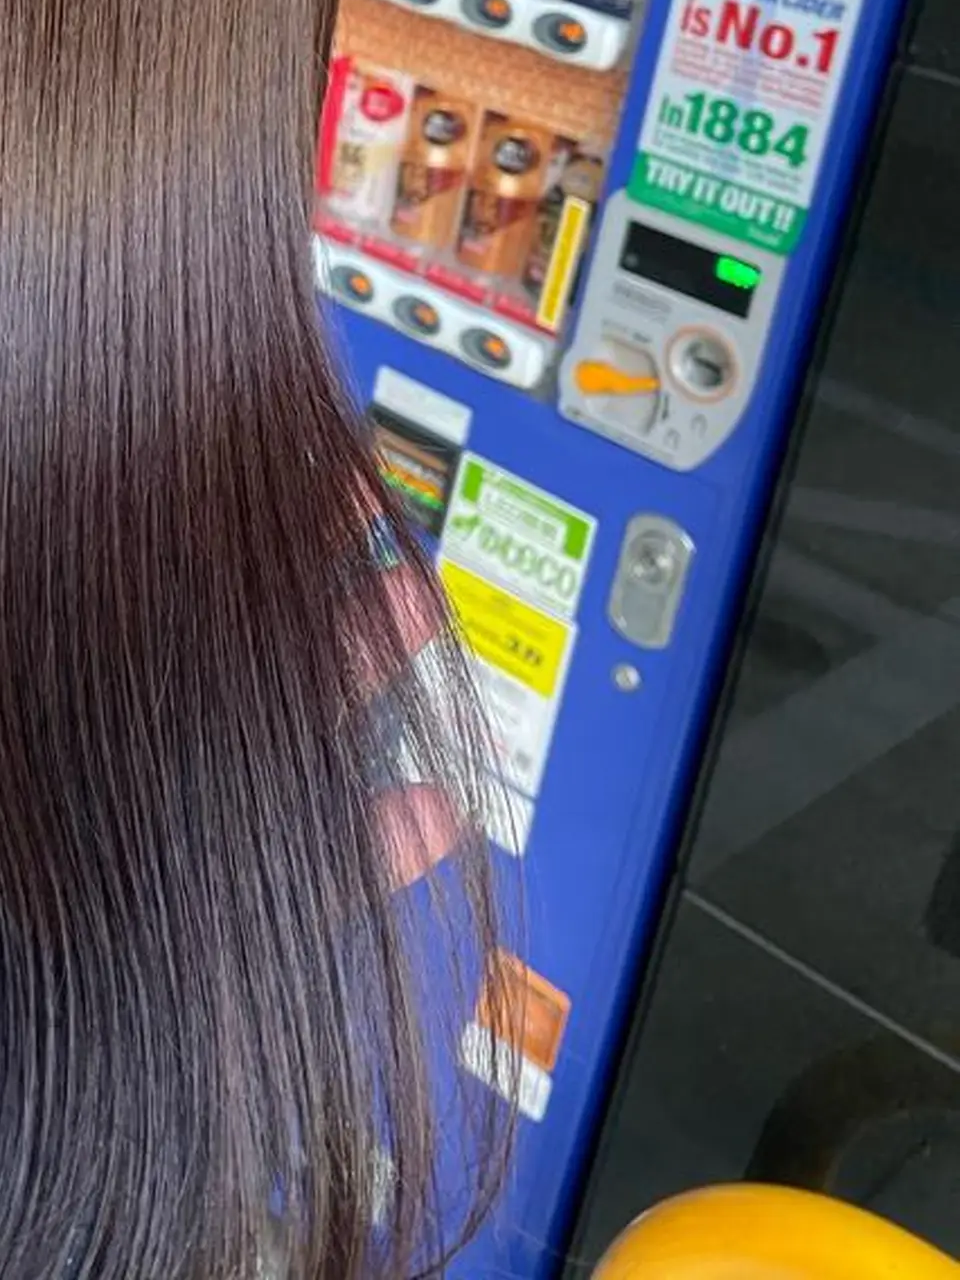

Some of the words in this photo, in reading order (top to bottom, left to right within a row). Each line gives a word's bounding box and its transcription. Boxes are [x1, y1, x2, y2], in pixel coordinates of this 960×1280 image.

[685, 92, 808, 167] 1884
[646, 158, 693, 196] TRY
[692, 174, 722, 207] IT
